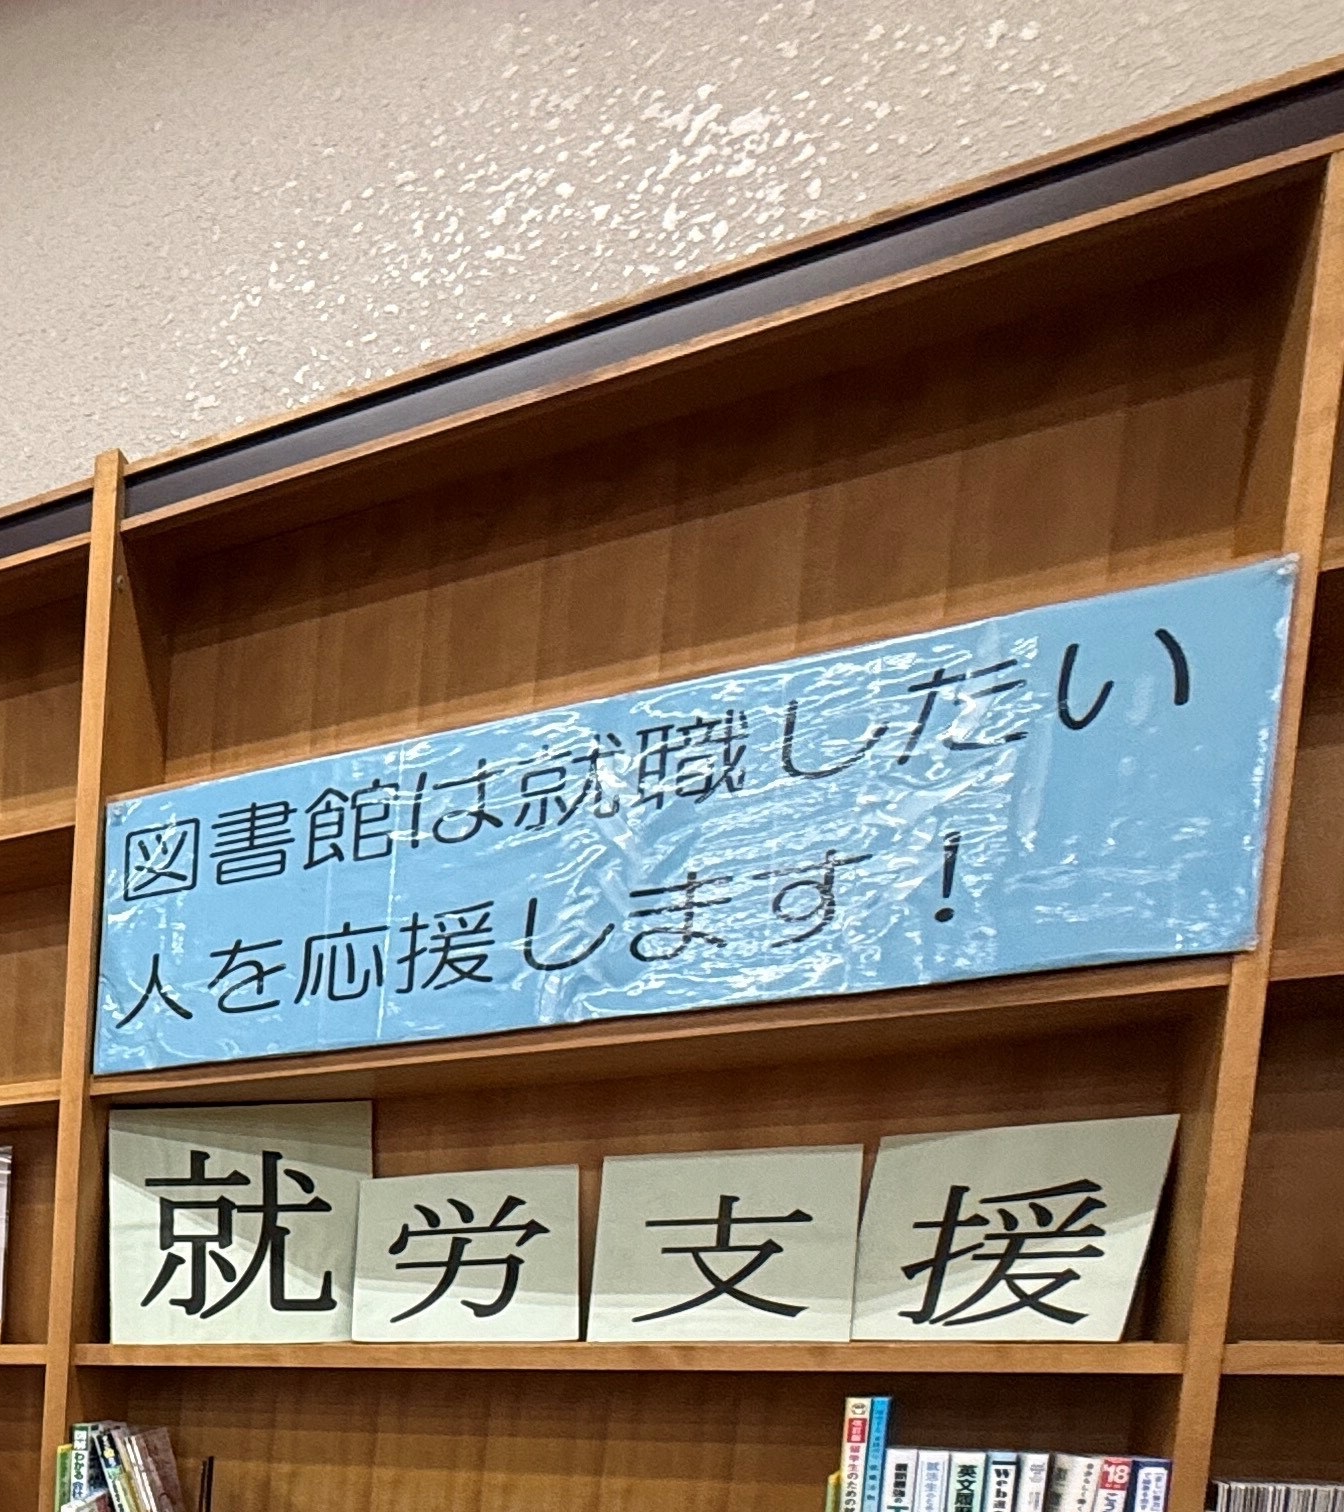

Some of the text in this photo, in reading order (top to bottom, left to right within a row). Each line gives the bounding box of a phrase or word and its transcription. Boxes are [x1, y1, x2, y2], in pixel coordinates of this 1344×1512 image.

[123, 629, 1191, 902] 図書館は就職したい
[143, 1149, 1109, 1327] 就労支援
